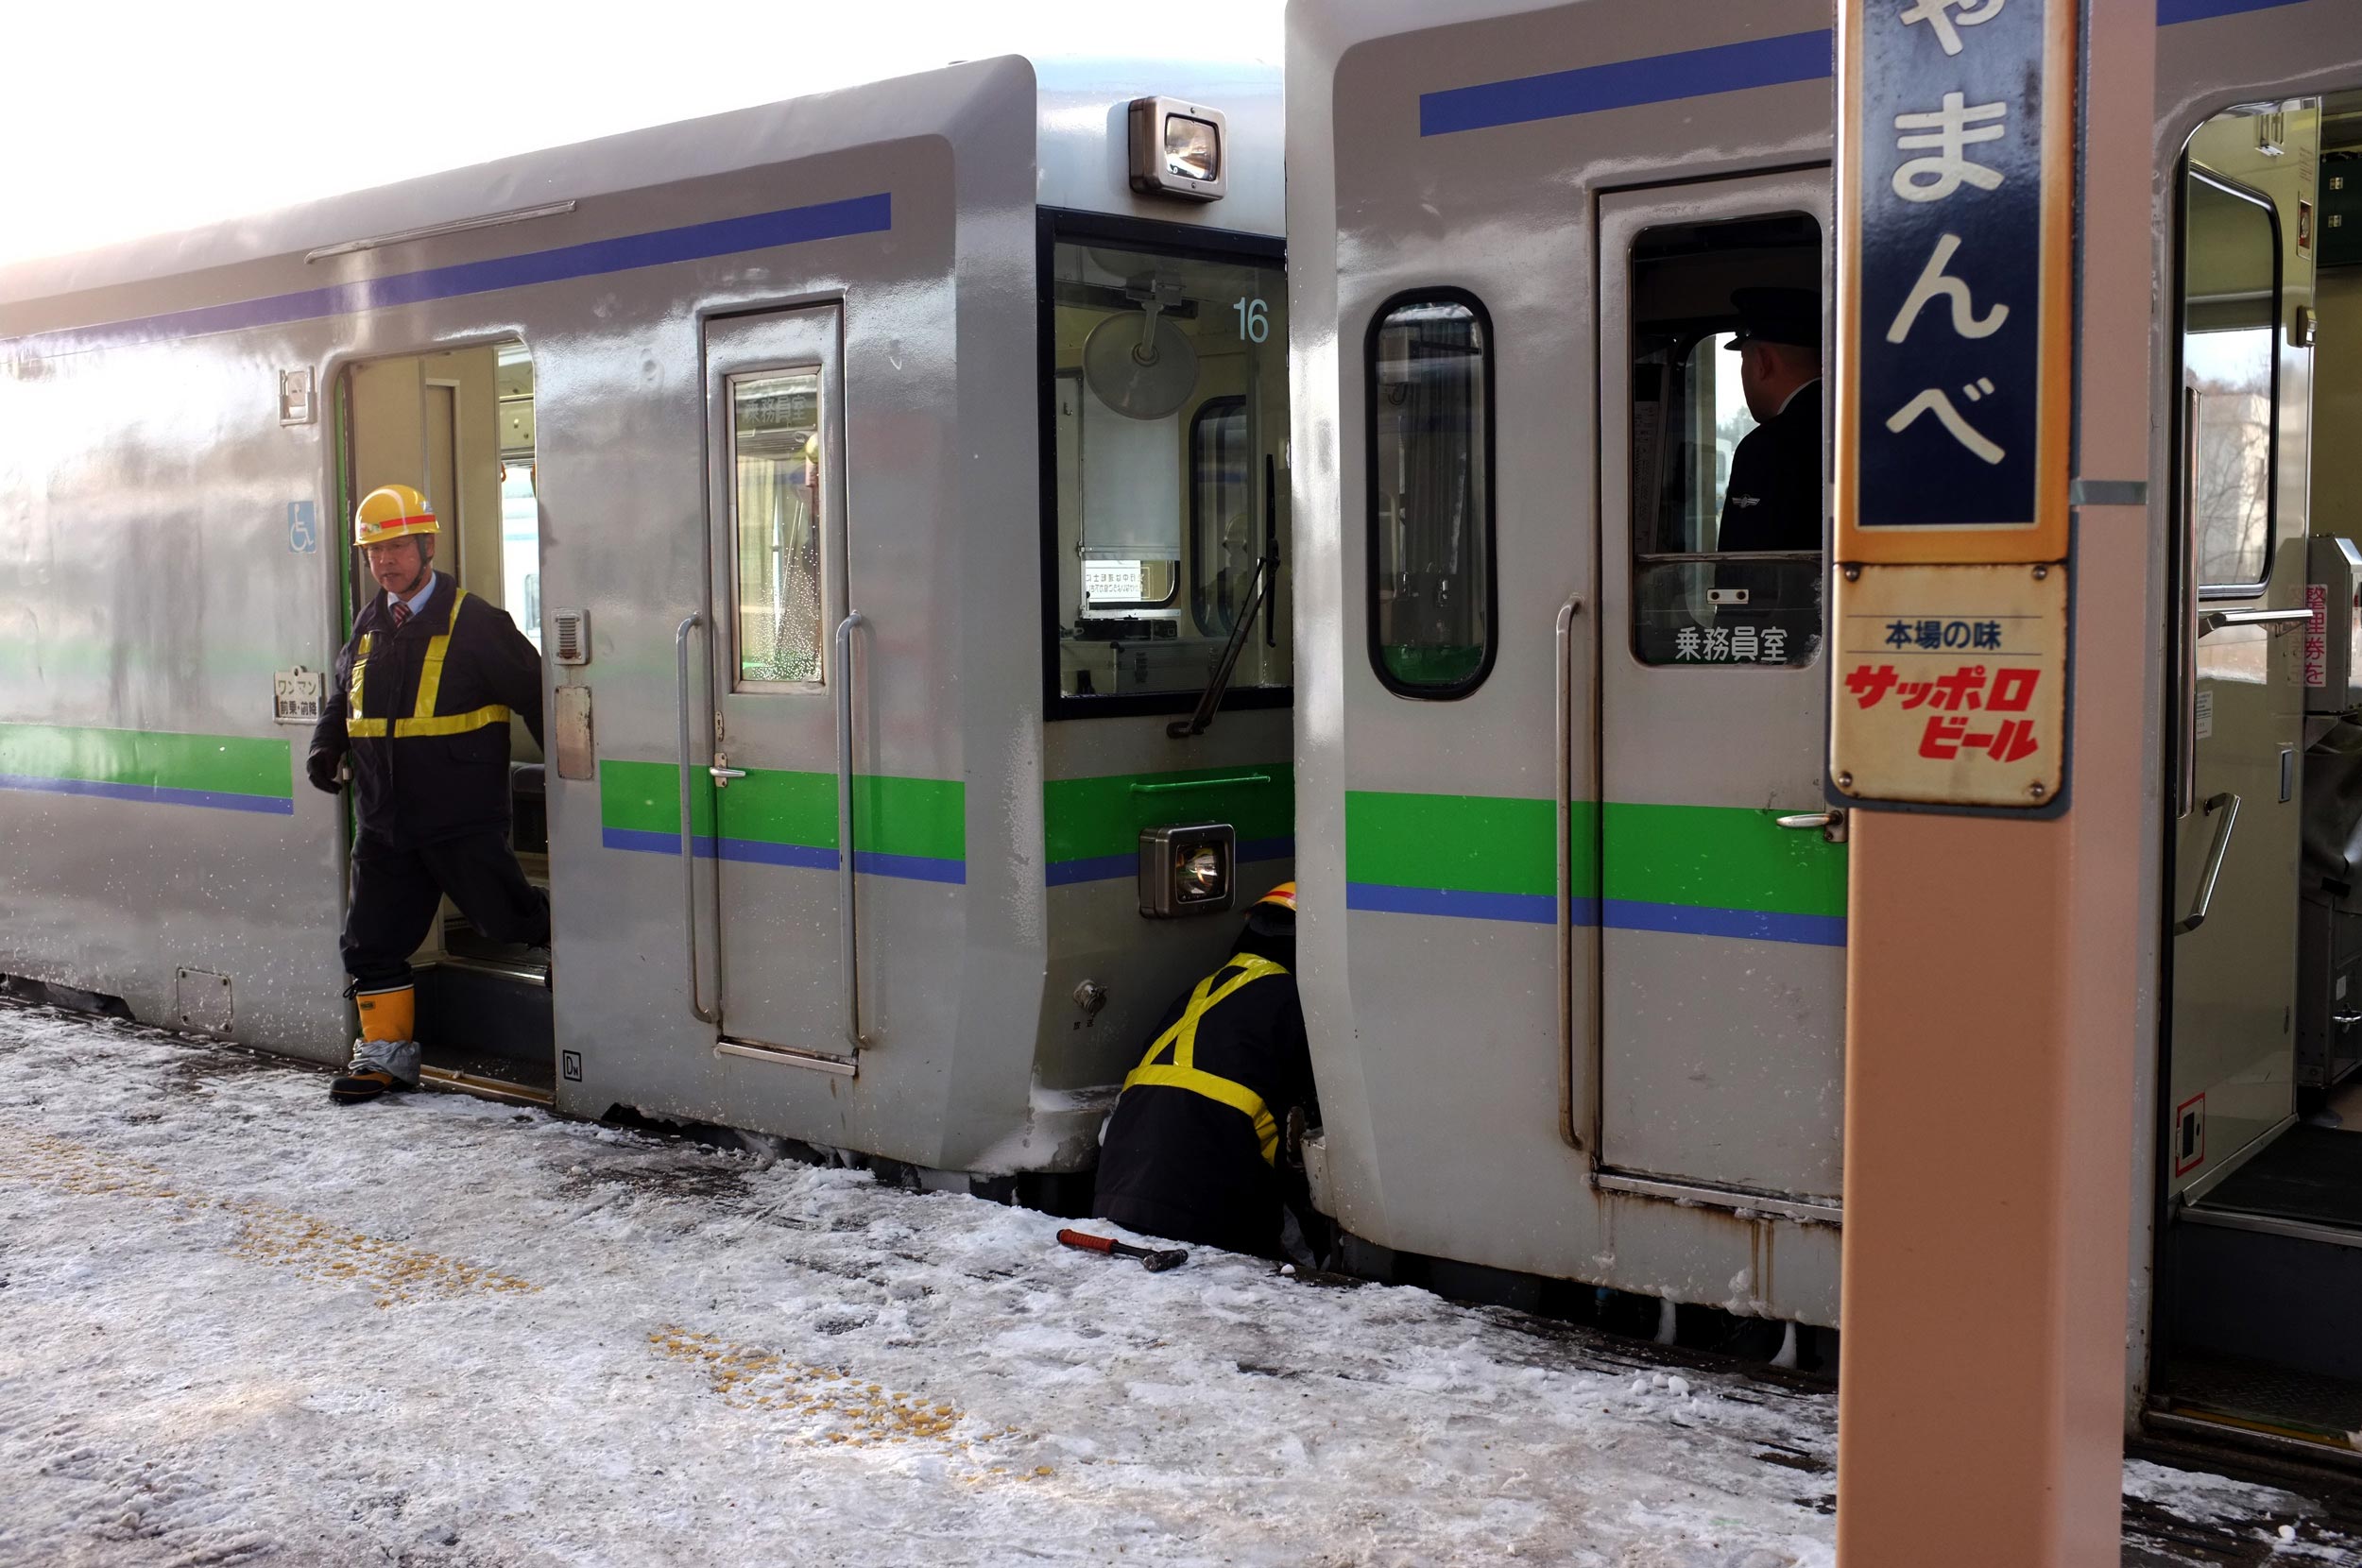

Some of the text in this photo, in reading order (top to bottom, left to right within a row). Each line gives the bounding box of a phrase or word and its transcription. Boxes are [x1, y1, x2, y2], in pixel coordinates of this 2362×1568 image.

[1233, 297, 1269, 344] 16
[744, 395, 807, 423] 乗務員室
[1674, 625, 1789, 662] 乗務員室
[1885, 620, 2002, 651] 本場の味
[278, 679, 317, 695] ワンマン
[1844, 665, 2042, 712] サッポロ
[1918, 716, 2039, 763] ビール
